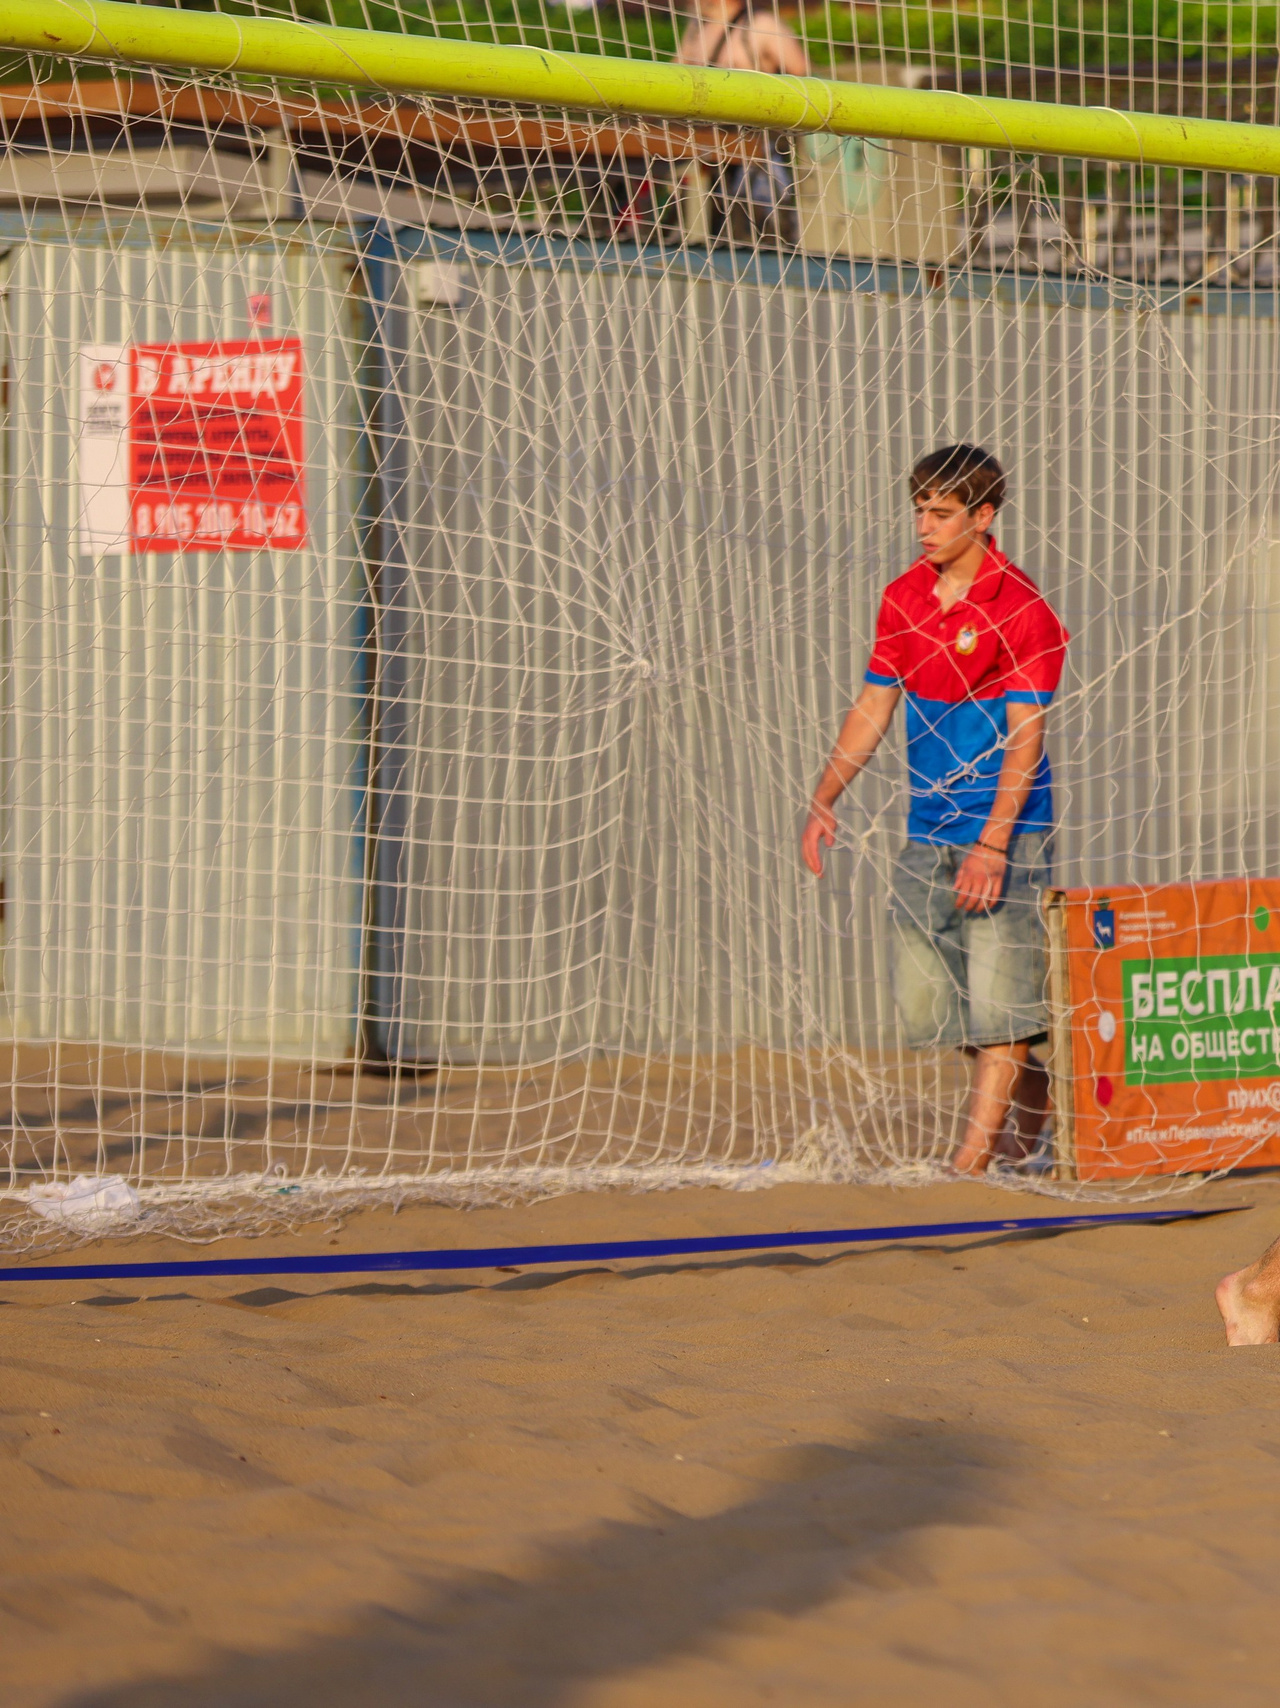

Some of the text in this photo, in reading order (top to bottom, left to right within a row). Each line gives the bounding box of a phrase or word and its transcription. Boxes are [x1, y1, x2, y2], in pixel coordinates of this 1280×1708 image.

[137, 352, 297, 399] В АРЕНДУ
[1132, 1035, 1164, 1062] НА
